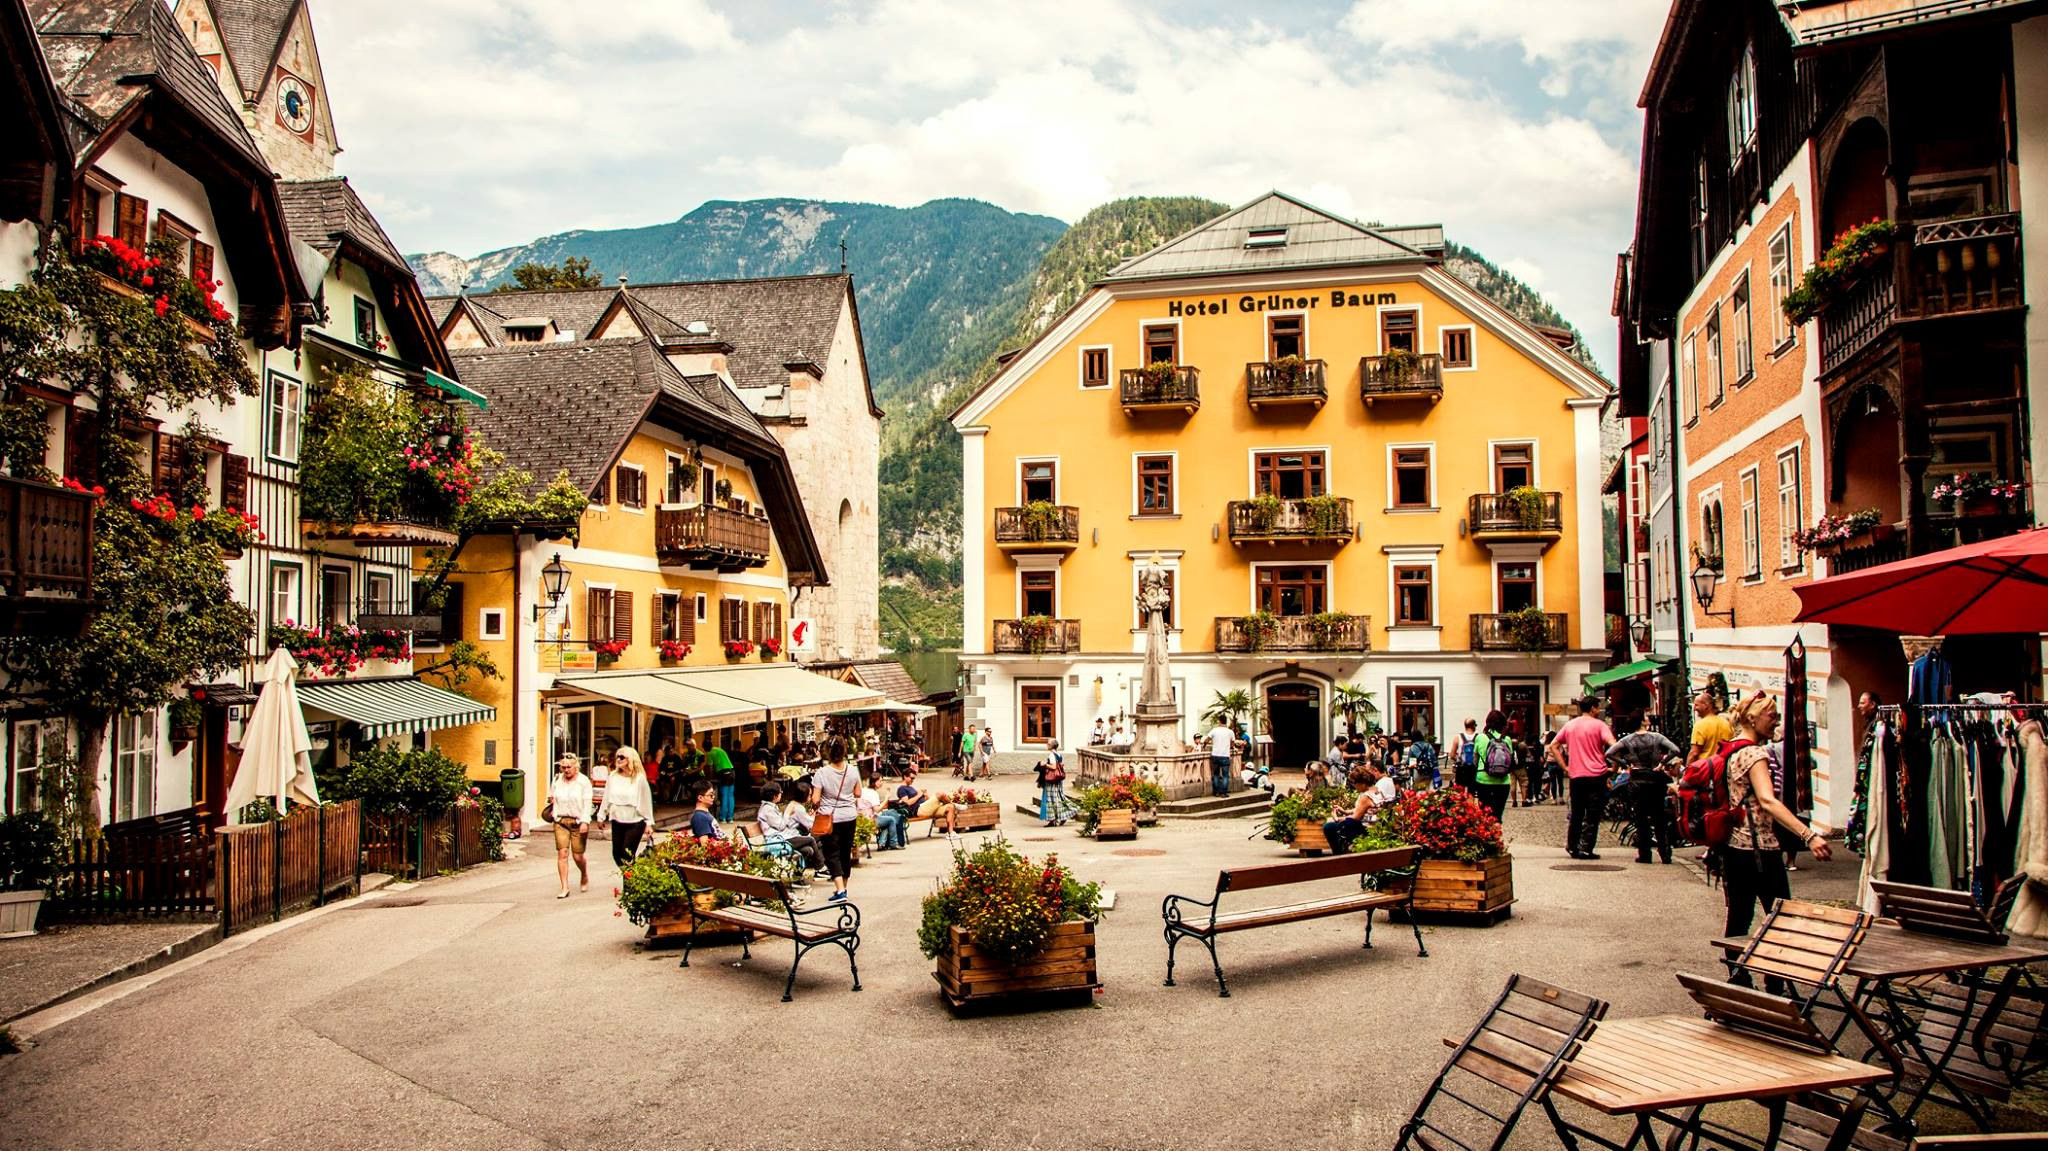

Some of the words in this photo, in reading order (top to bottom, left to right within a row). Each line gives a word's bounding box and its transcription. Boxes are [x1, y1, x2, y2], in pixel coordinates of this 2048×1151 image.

[1169, 299, 1227, 317] Hotel
[1239, 295, 1319, 312] Grüner
[1331, 291, 1397, 307] Baum
